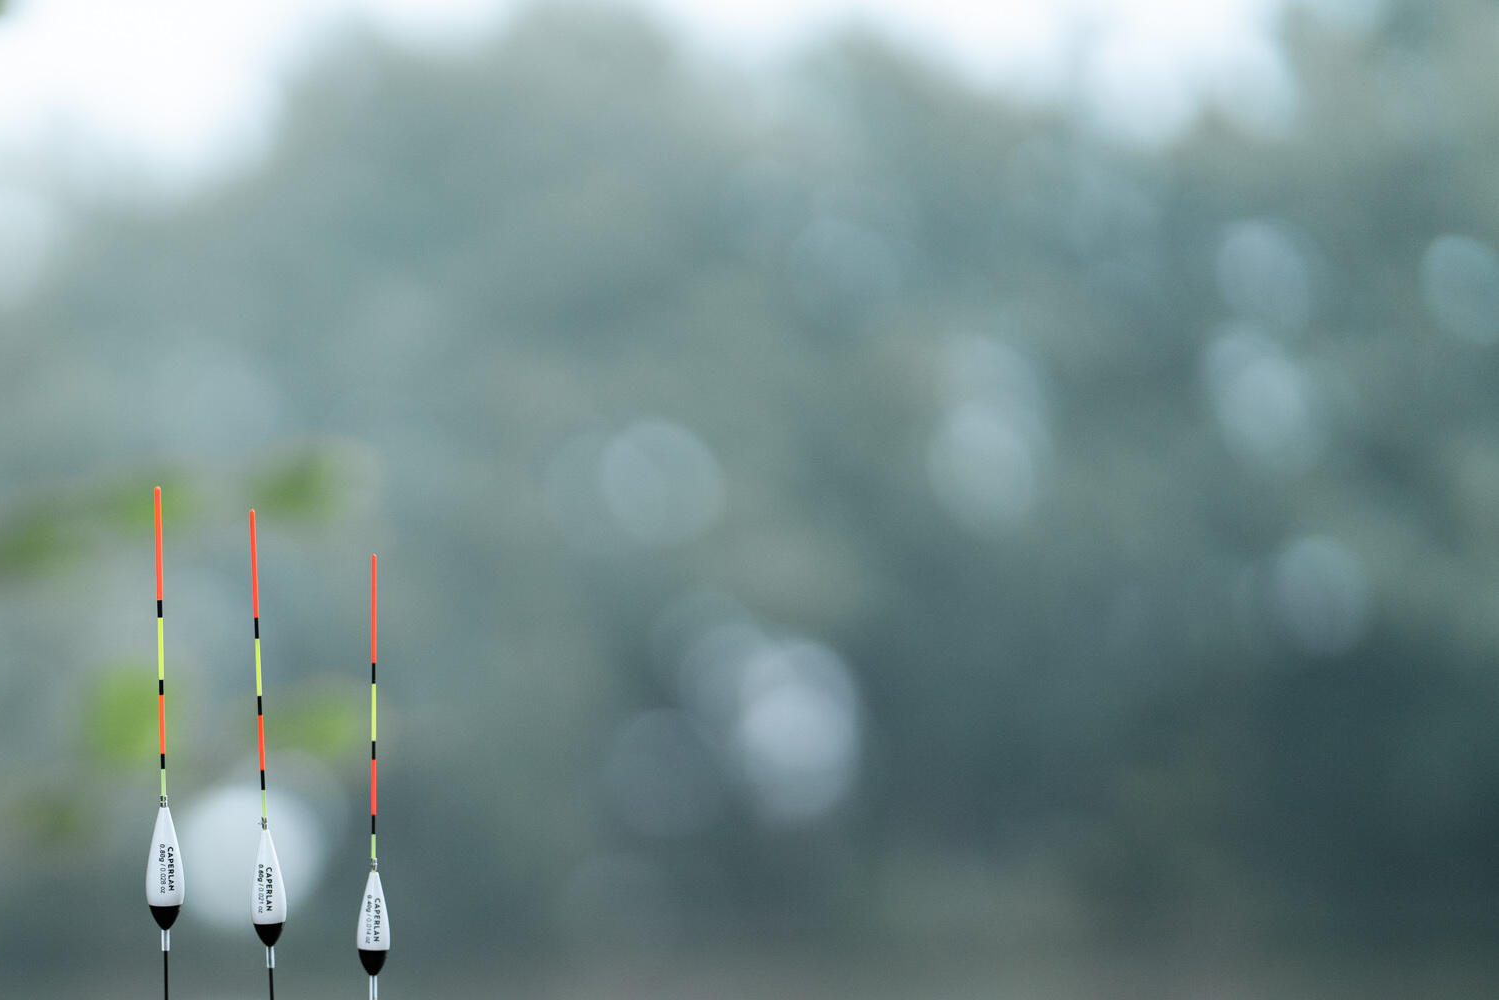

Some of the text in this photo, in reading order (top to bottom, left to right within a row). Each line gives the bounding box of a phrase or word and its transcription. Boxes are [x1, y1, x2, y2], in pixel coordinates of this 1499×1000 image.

[159, 867, 167, 885] 0.028
[167, 846, 175, 891] CAPERLAN
[160, 886, 166, 894] oz
[265, 866, 273, 912] CAPERLAN
[258, 905, 263, 914] oz
[373, 897, 381, 942] CAPERLAN
